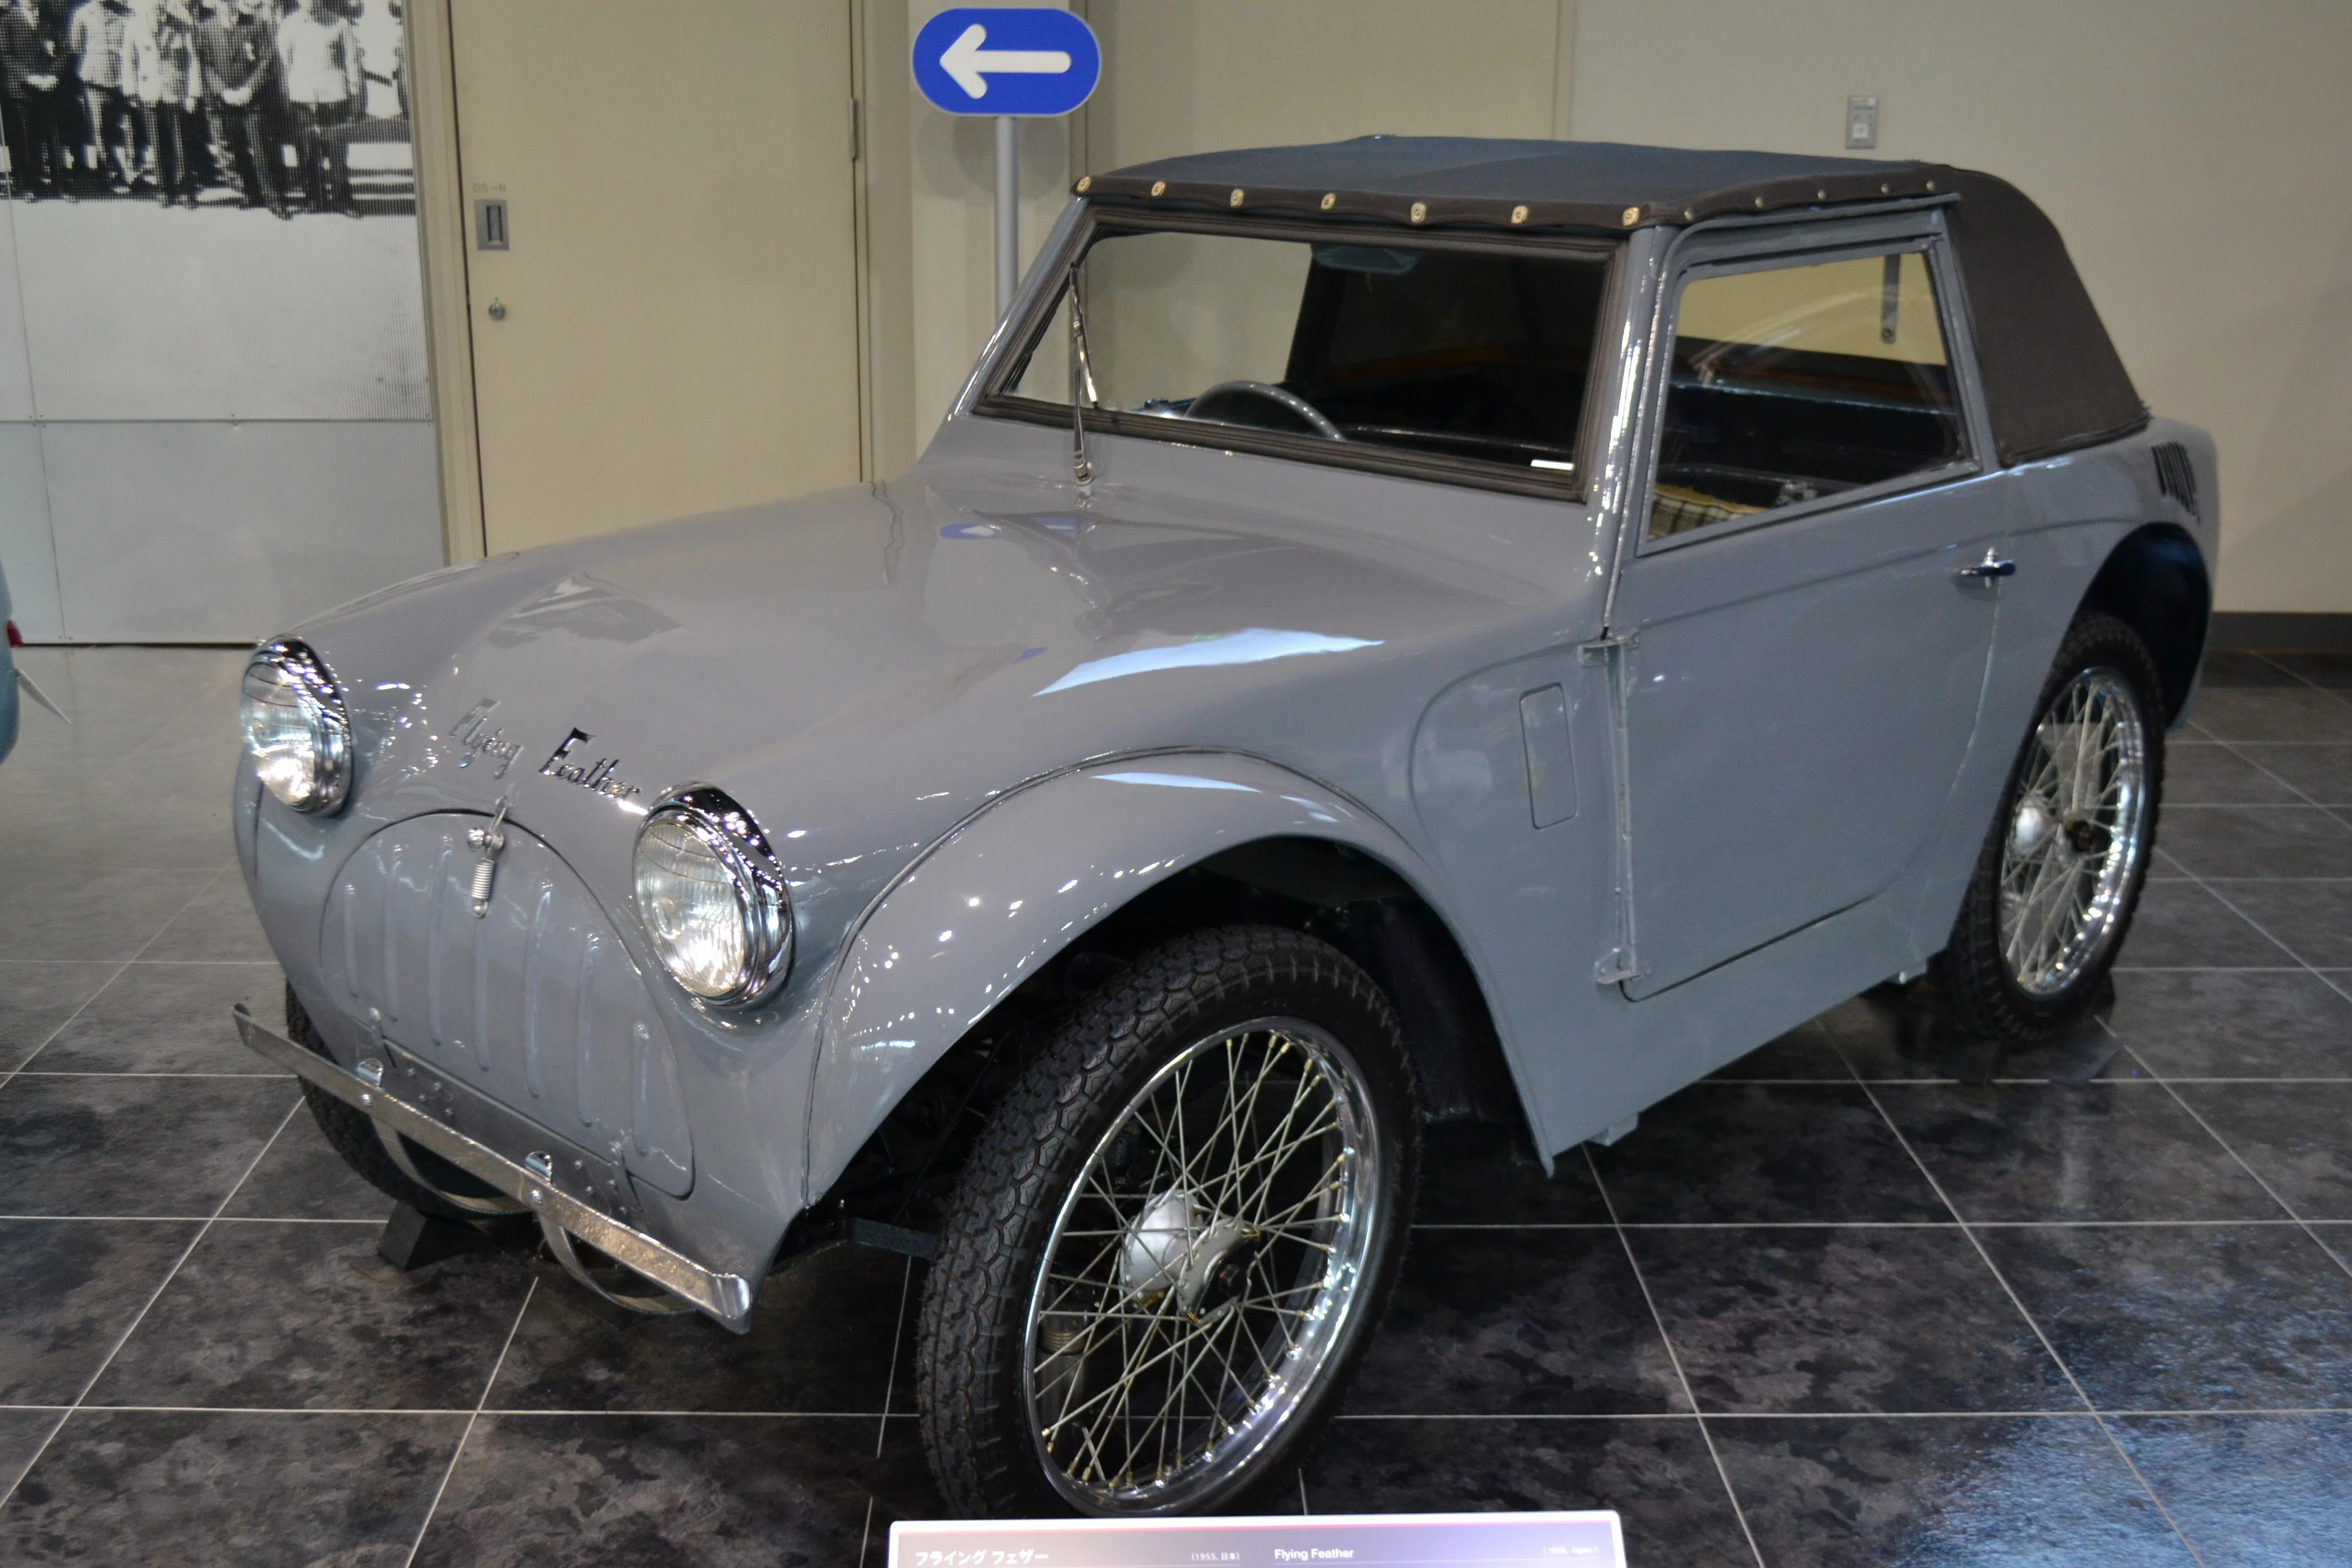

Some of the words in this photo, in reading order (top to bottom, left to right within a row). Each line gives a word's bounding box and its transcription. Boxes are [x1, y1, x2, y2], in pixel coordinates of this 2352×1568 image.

[446, 697, 524, 780] Flying
[539, 727, 641, 800] Feather
[915, 1549, 987, 1566] フライング
[992, 1549, 1049, 1565] フェザー
[1191, 1552, 1219, 1561] (1955,
[1275, 1549, 1309, 1561] Flying
[1311, 1548, 1354, 1558] Feather
